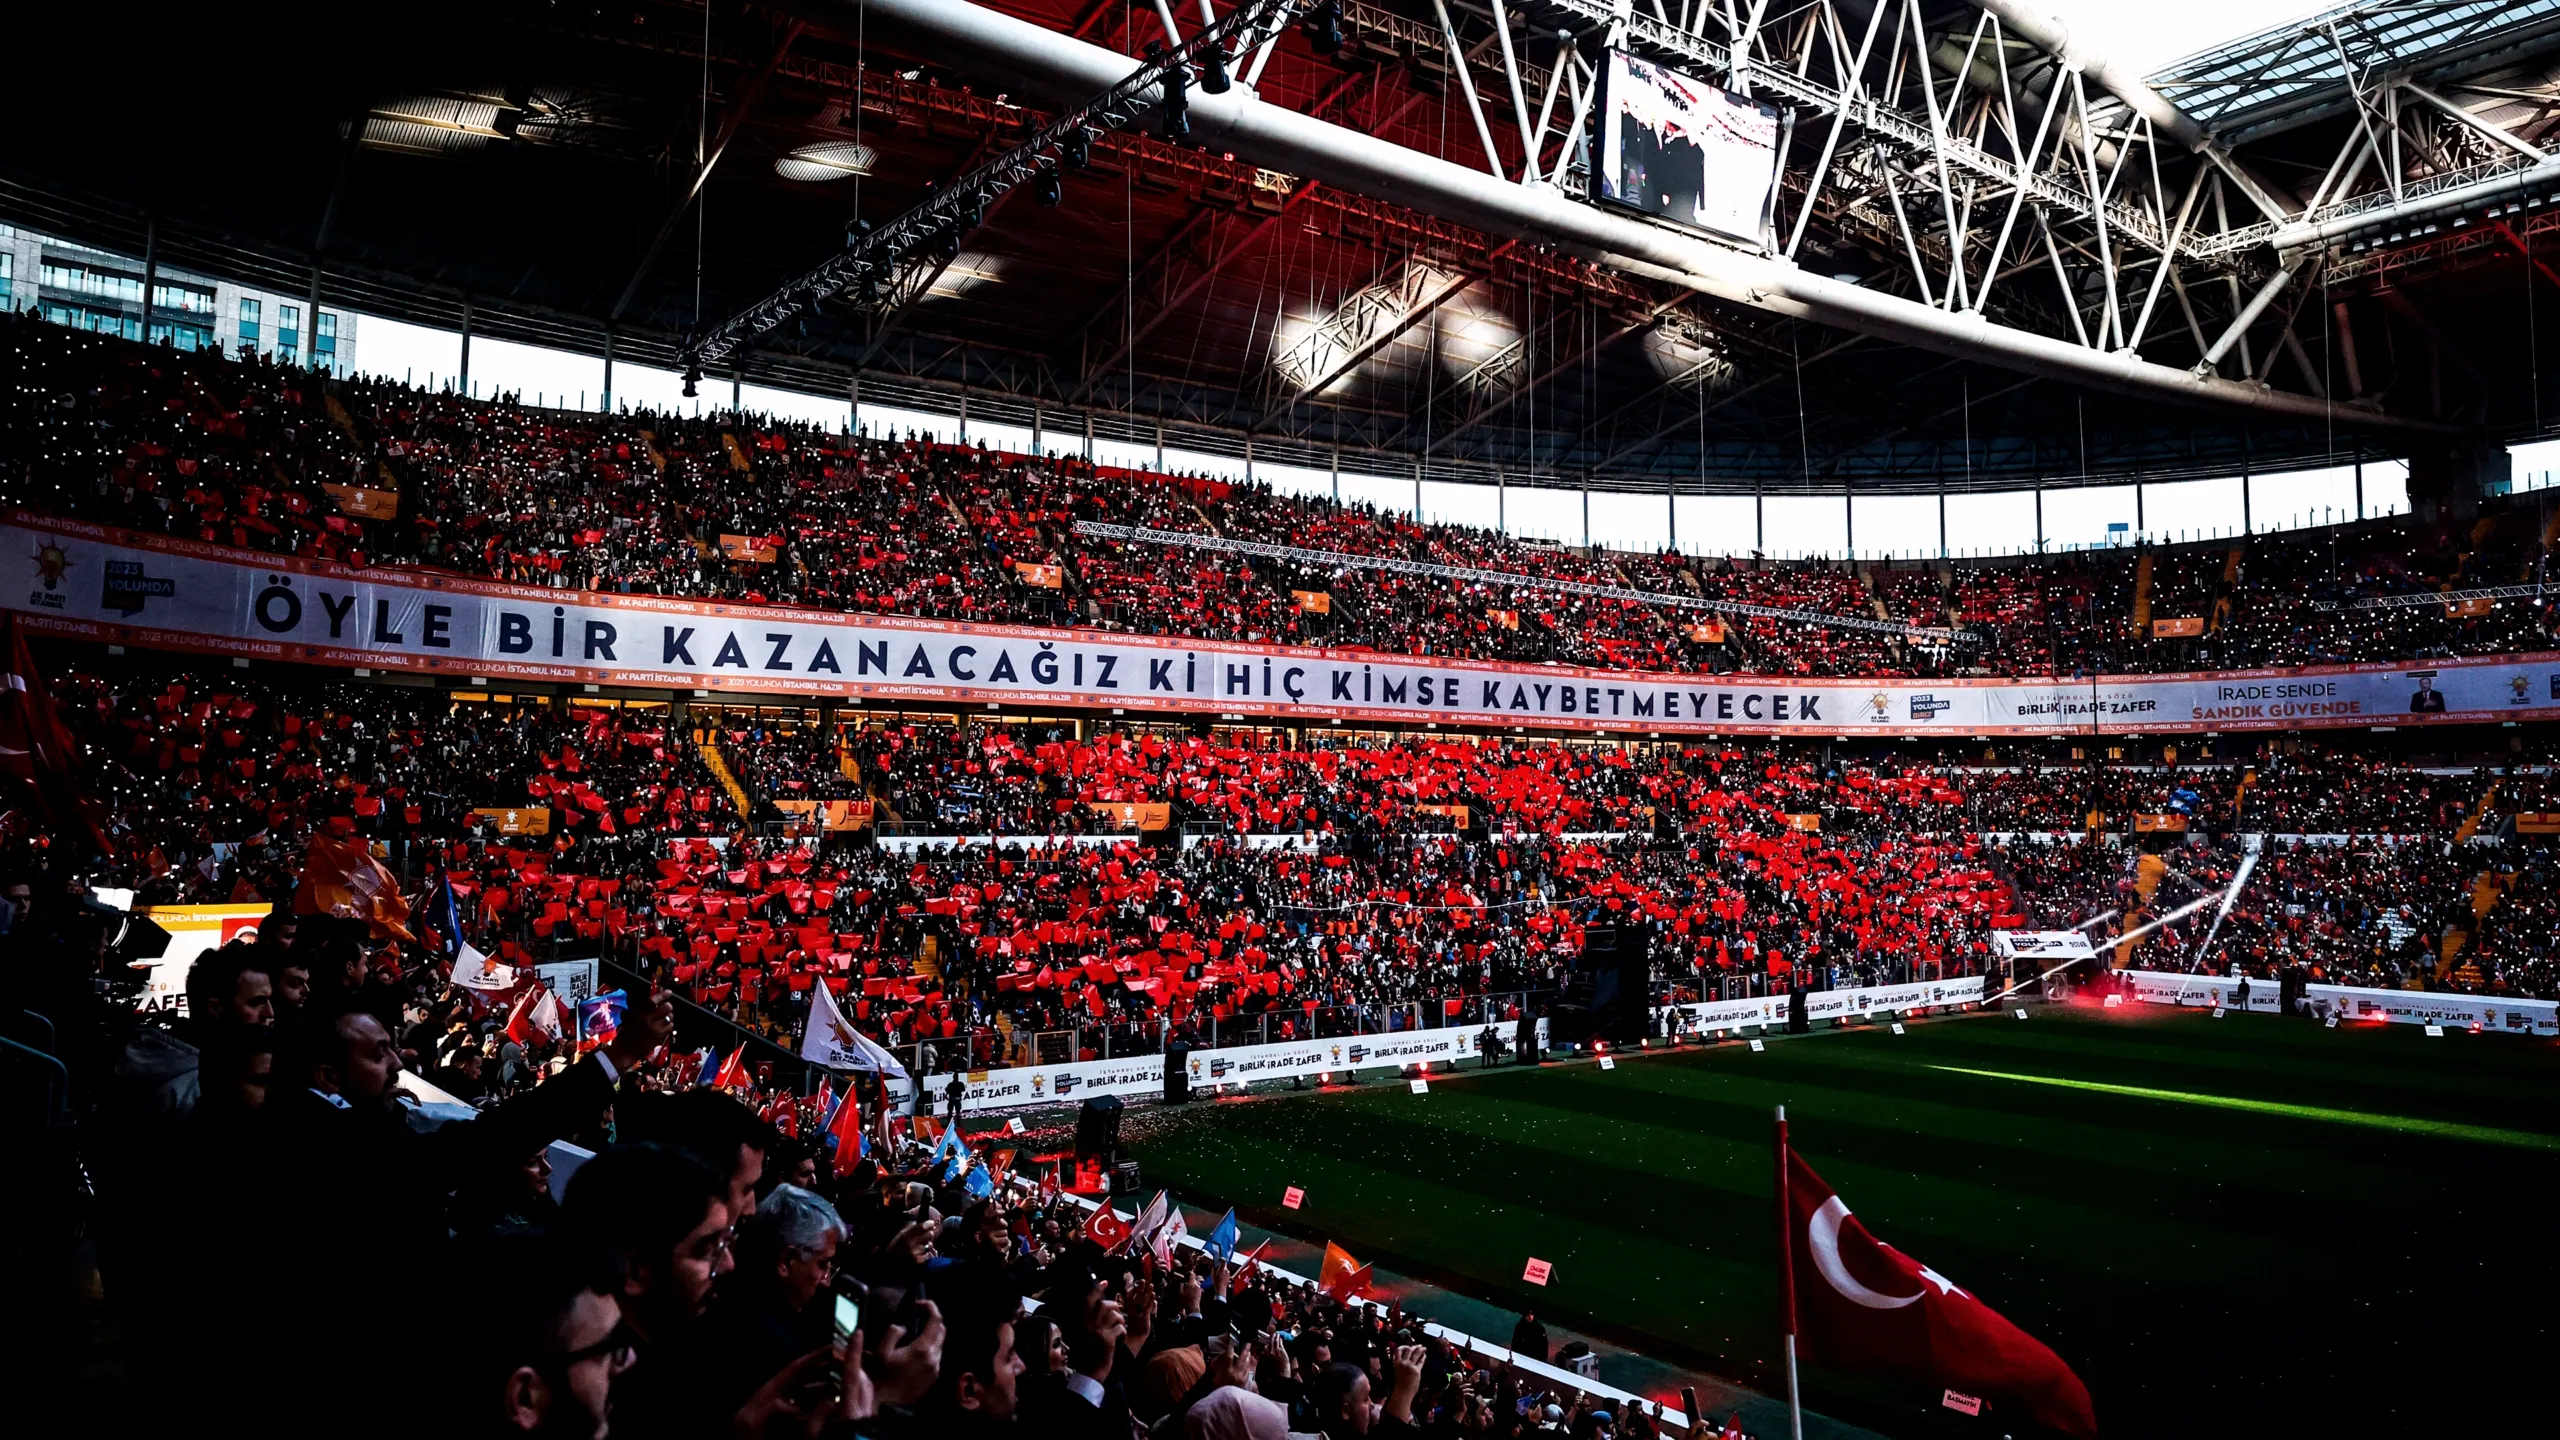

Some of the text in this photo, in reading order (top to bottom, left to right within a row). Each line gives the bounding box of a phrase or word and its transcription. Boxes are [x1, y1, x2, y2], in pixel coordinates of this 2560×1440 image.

[146, 536, 167, 549] 2023
[167, 539, 212, 555] YOLUNDA
[257, 553, 285, 567] HAZIR
[107, 564, 140, 576] 2023
[330, 565, 341, 575] AK
[108, 579, 172, 593] YOLUNDA
[450, 580, 468, 590] 2023
[469, 582, 510, 594] YOLUNDA
[553, 591, 579, 602] HAZIR
[619, 599, 633, 609] AK
[730, 607, 747, 615] 2023
[748, 609, 785, 618] YOLUNDA
[823, 614, 846, 623] HAZIR
[880, 619, 891, 627] AK
[990, 626, 1021, 635] YOLUNDA
[1052, 631, 1072, 639] HAZIR
[255, 573, 1822, 720] ÖYLE BİR KAZANACAĞIZ Kİ HİÇ KİMSE KAYBETMEYECEK
[324, 650, 337, 660] AK
[446, 661, 465, 670] 2023
[466, 662, 506, 673] YOLUNDA
[549, 668, 576, 678] HAZIR
[615, 672, 632, 681] AK
[728, 679, 745, 687] 2023
[746, 680, 782, 689] YOLUNDA
[820, 683, 844, 692] HAZIR
[2218, 683, 2337, 701] İRADE SENDE
[988, 692, 1019, 700] YOLUNDA
[1051, 694, 1071, 702] HAZIR
[1913, 702, 1949, 710] YOLUNDA
[2112, 700, 2156, 714] ZAFER
[2192, 701, 2361, 720] SANDIK GÜVENDE
[1905, 993, 1919, 1003] ZAFER
[1827, 1001, 1843, 1011] ZAFER
[1741, 1010, 1758, 1020] ZAFER
[2445, 1013, 2474, 1021] ZAFER
[1425, 1042, 1449, 1054] ZAFER
[1296, 1054, 1322, 1067] ZAFER
[1087, 1073, 1149, 1089] BİRLİK İRADE
[988, 1085, 1020, 1099] ZAFER
